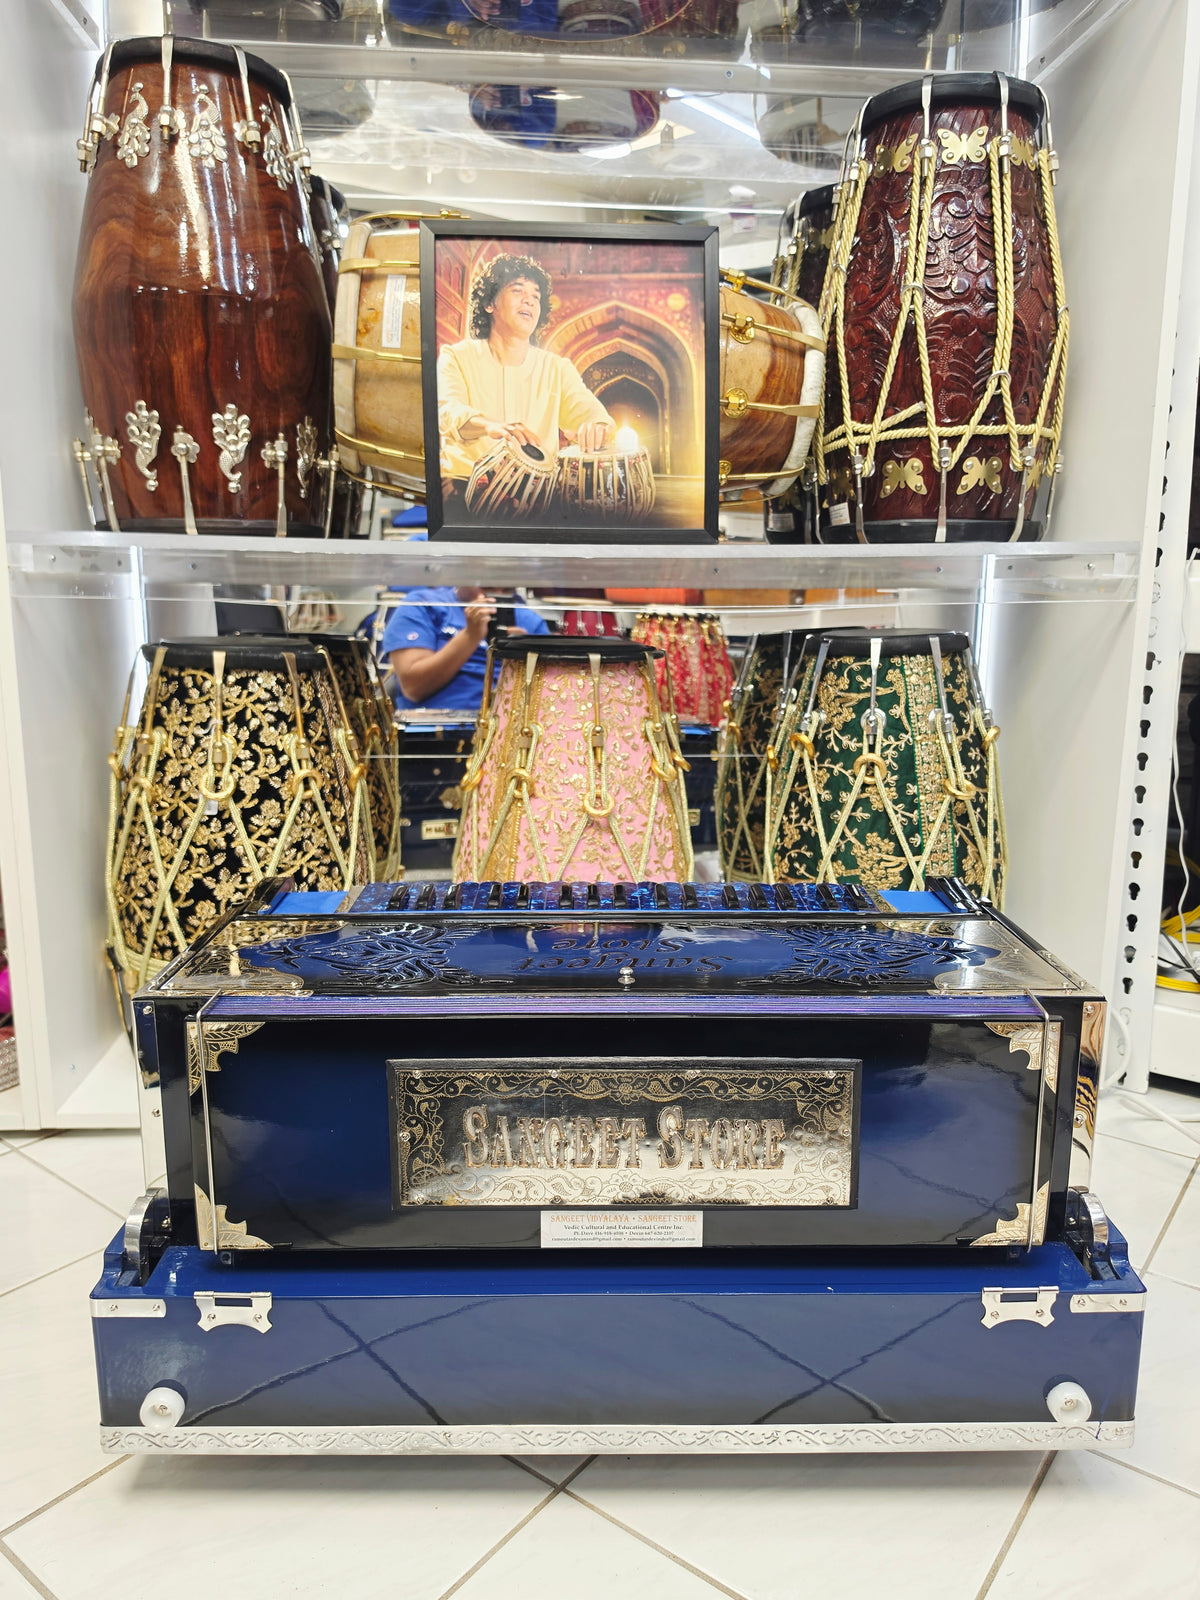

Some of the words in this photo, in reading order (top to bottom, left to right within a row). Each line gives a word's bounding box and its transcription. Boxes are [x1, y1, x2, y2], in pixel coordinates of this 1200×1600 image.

[551, 937, 695, 953] Store
[514, 952, 733, 972] Sangeet
[463, 1104, 647, 1169] SANGEET
[657, 1105, 785, 1169] STORE
[550, 1214, 585, 1223] SANGEET
[586, 1213, 630, 1223] VIDYALAYA
[638, 1214, 673, 1223] SANGEET
[673, 1214, 697, 1223] STORE
